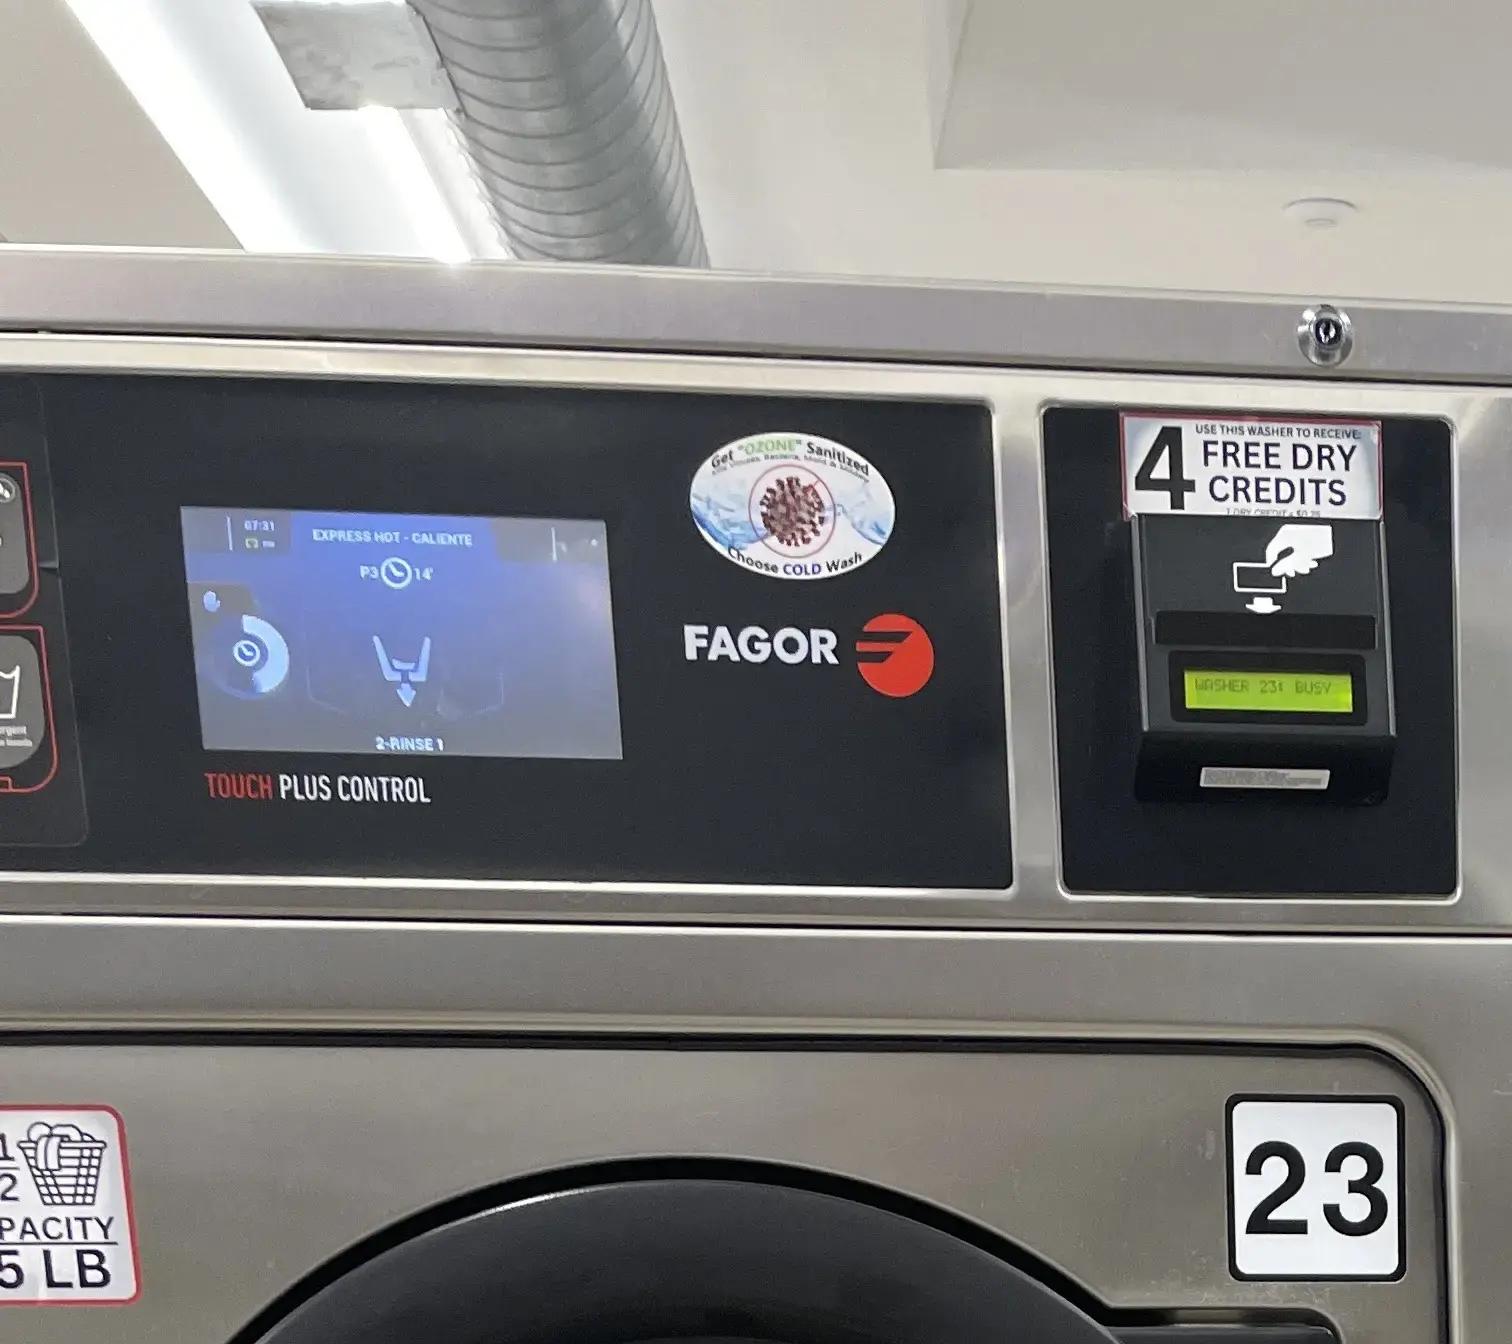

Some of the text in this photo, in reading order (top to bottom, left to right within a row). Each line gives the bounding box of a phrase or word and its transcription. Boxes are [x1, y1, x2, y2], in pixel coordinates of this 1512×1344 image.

[1195, 424, 1217, 435] USE
[1220, 424, 1245, 436] THIS
[1247, 425, 1293, 438] WASHER
[1295, 427, 1311, 438] TO
[711, 449, 733, 468] Get
[806, 441, 869, 477] Sanitized
[1134, 425, 1196, 511] 4
[1203, 439, 1357, 472] FREE DRY
[1208, 475, 1347, 506] CREDITS
[312, 528, 371, 544] EXPRESS
[374, 530, 400, 545] HOT
[411, 531, 473, 546] CALIENTE
[359, 565, 379, 579] P3
[727, 546, 862, 576] Choose COLD Wash
[683, 624, 840, 665] FAGOR
[1195, 677, 1250, 693] WASHER
[1295, 680, 1332, 695] BUSY
[375, 735, 444, 751] 2-RINSE 1
[204, 772, 432, 803] TOUCH PLUS CONTROL
[1245, 1140, 1388, 1237] 23
[43, 1249, 111, 1289] LB
